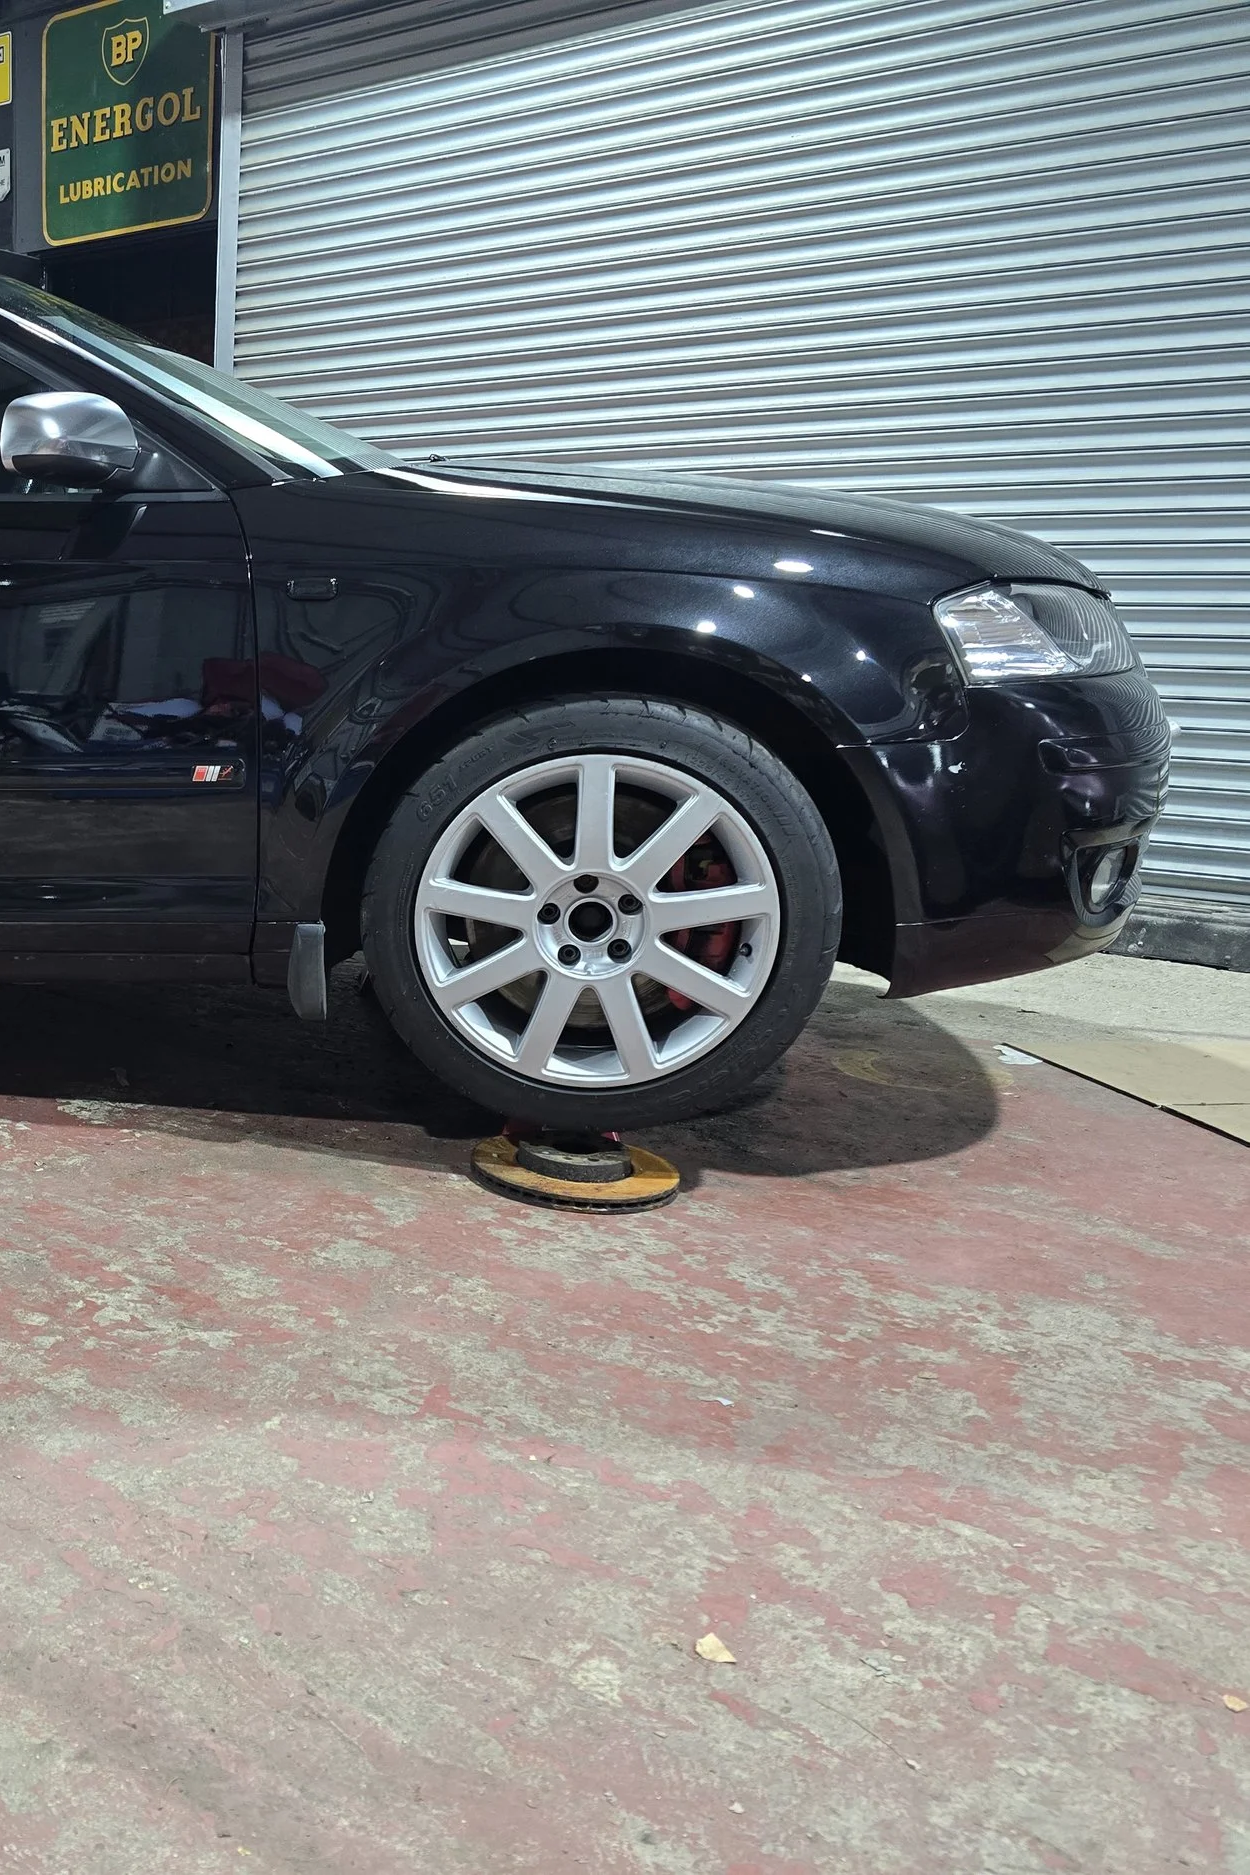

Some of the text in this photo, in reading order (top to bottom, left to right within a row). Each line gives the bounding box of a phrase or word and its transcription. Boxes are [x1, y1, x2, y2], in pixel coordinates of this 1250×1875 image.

[110, 30, 143, 67] BP
[50, 87, 201, 153] ENERGOL
[59, 158, 192, 204] LUBRICATION
